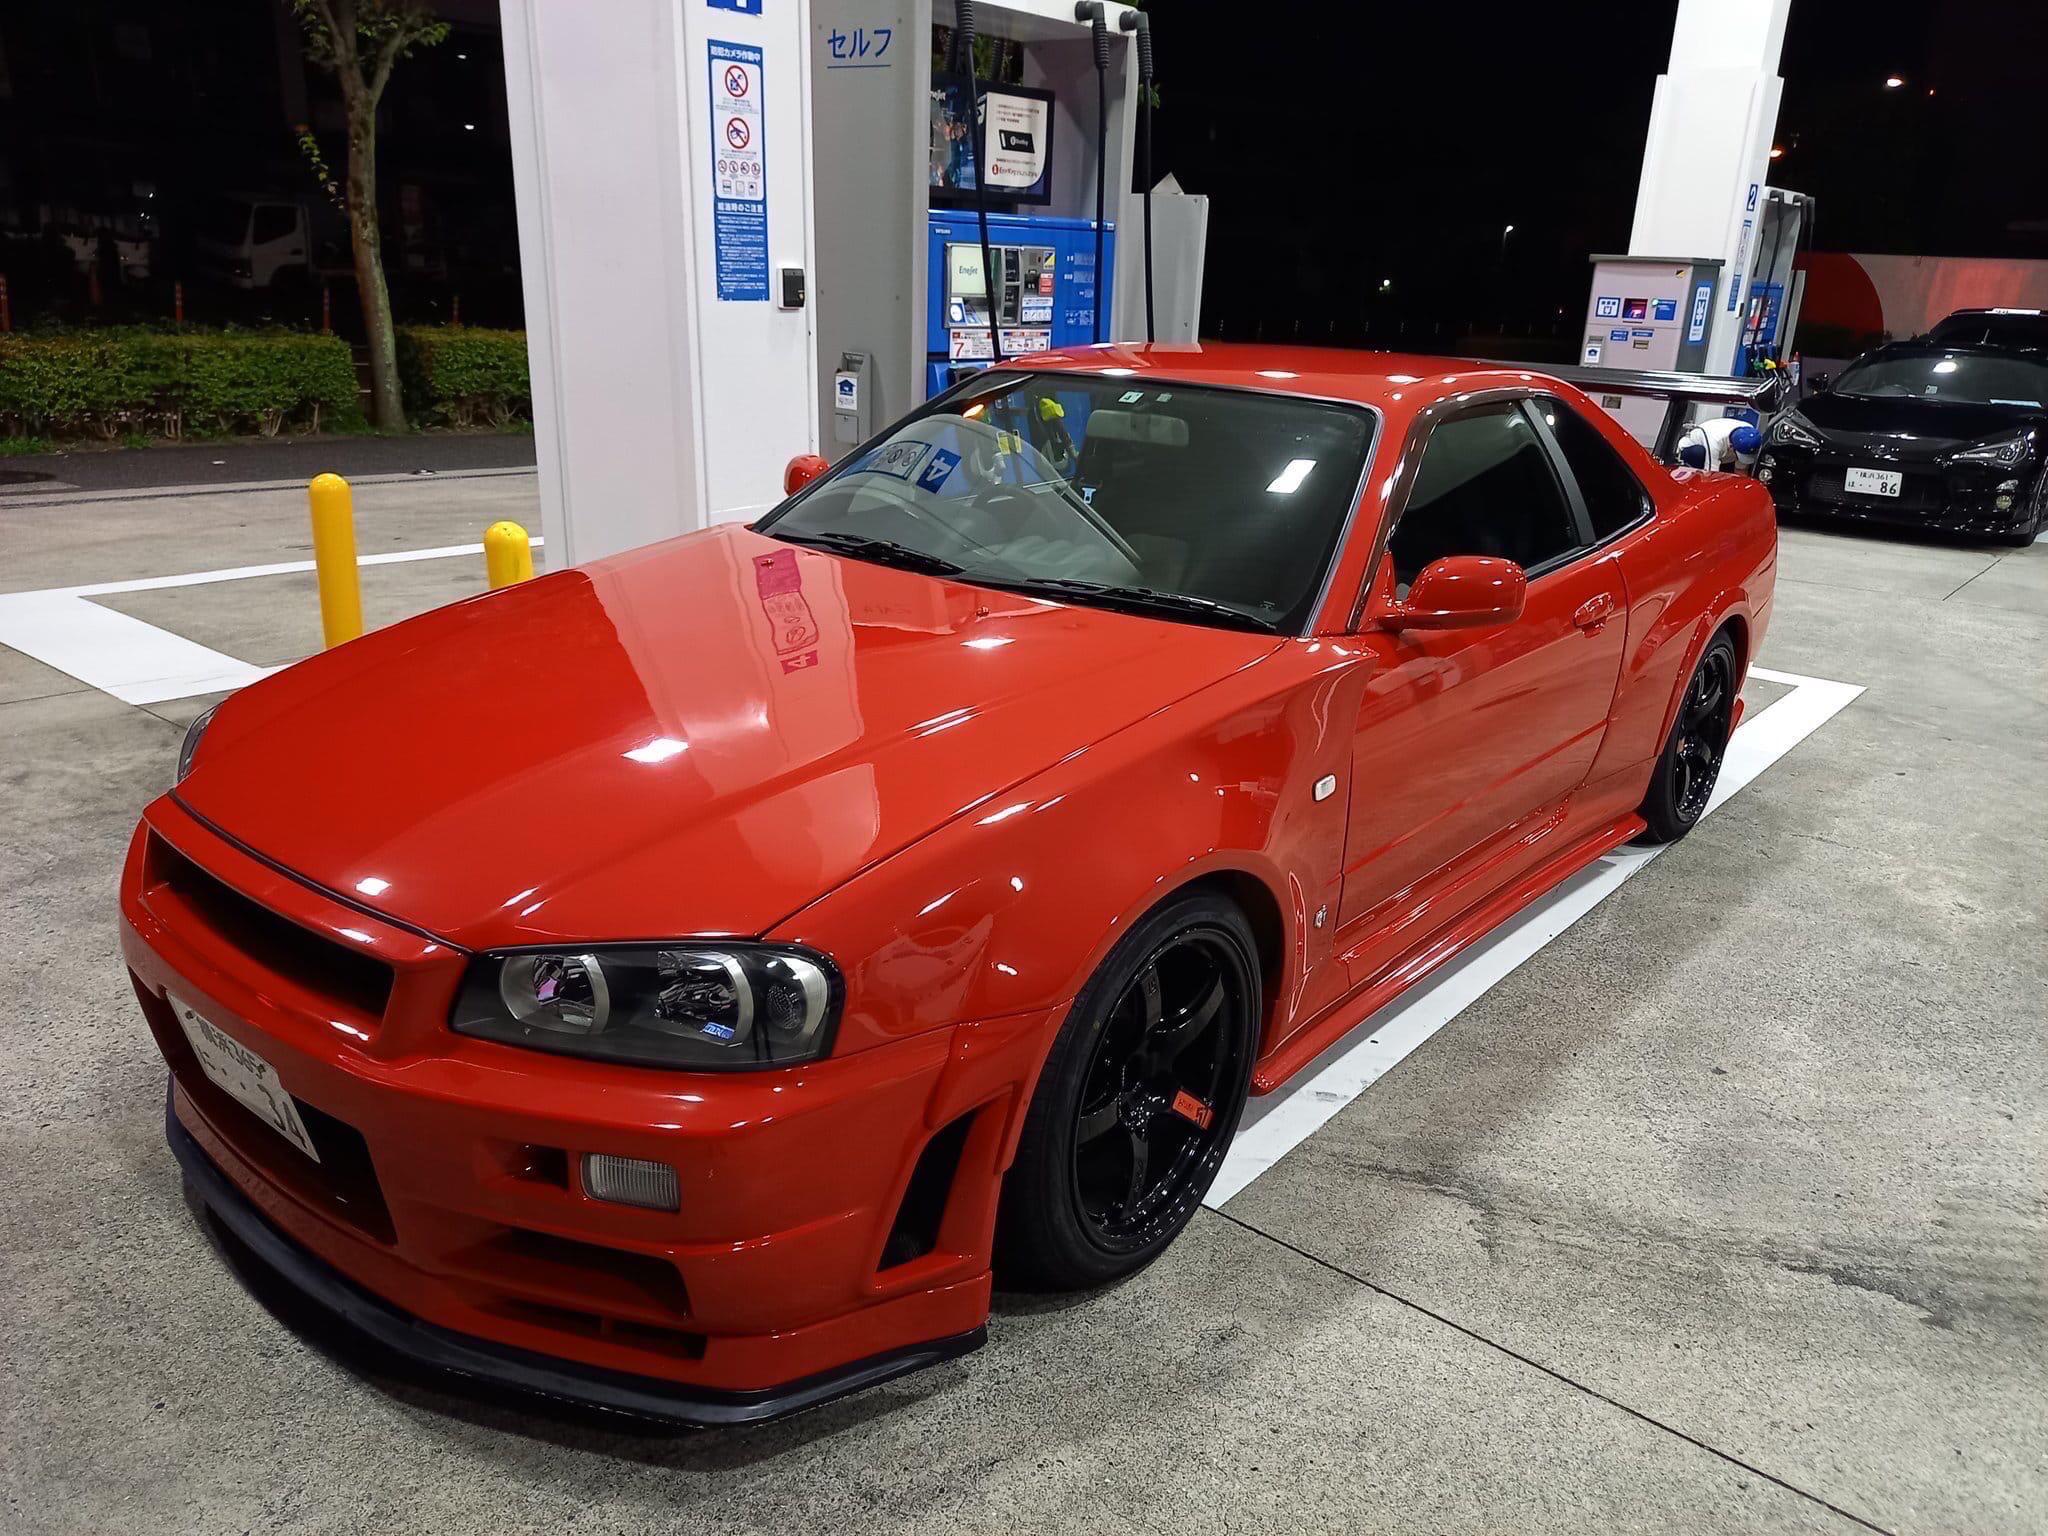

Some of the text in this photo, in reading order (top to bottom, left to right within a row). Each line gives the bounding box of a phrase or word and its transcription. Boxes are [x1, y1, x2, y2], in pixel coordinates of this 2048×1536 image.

[827, 28, 891, 58] セルフ
[1747, 185, 1757, 211] 2
[959, 266, 978, 276] EneJet
[954, 342, 964, 357] 7
[1880, 481, 1897, 495] 86
[257, 1083, 308, 1150] 34
